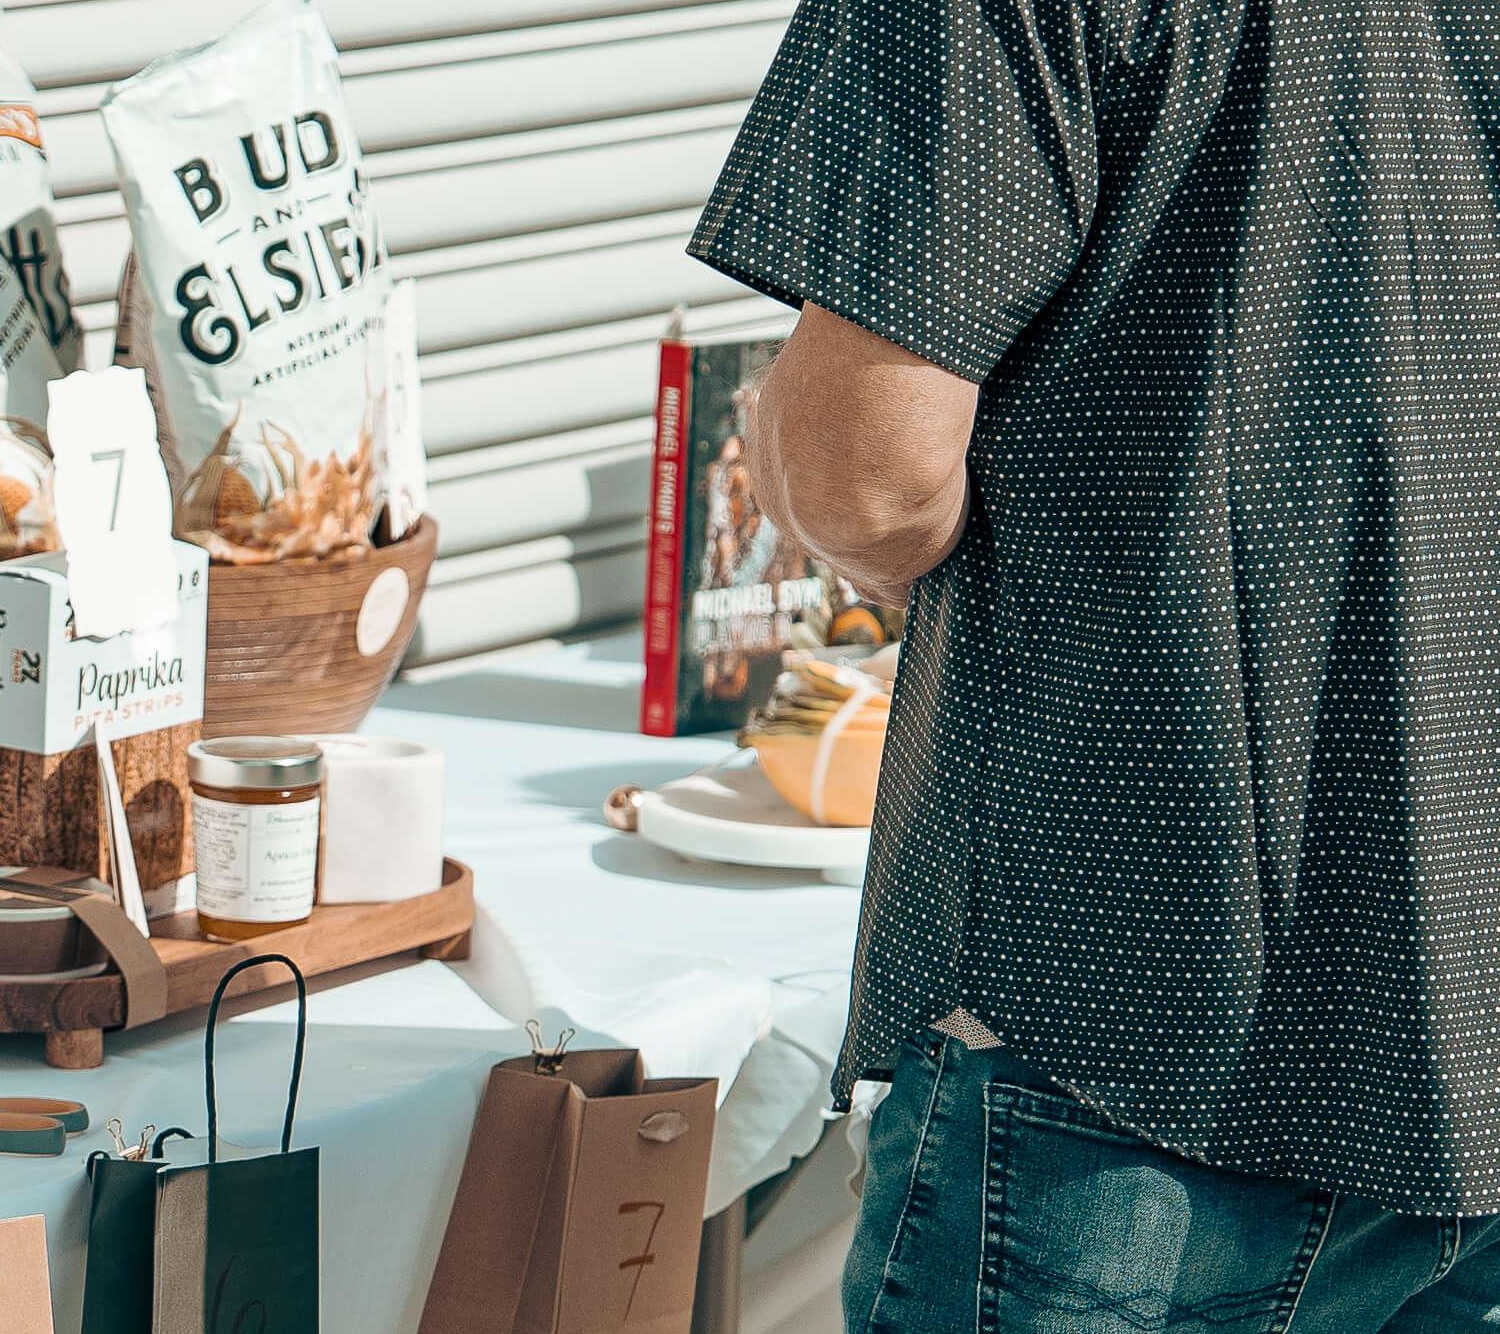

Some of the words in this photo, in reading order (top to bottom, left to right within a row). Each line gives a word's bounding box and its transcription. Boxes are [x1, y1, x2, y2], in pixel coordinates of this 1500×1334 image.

[88, 448, 127, 533] 7
[777, 576, 824, 612] SYM
[77, 650, 184, 711] Paprika
[122, 691, 185, 721] STRIPS
[617, 1200, 667, 1321] 7
